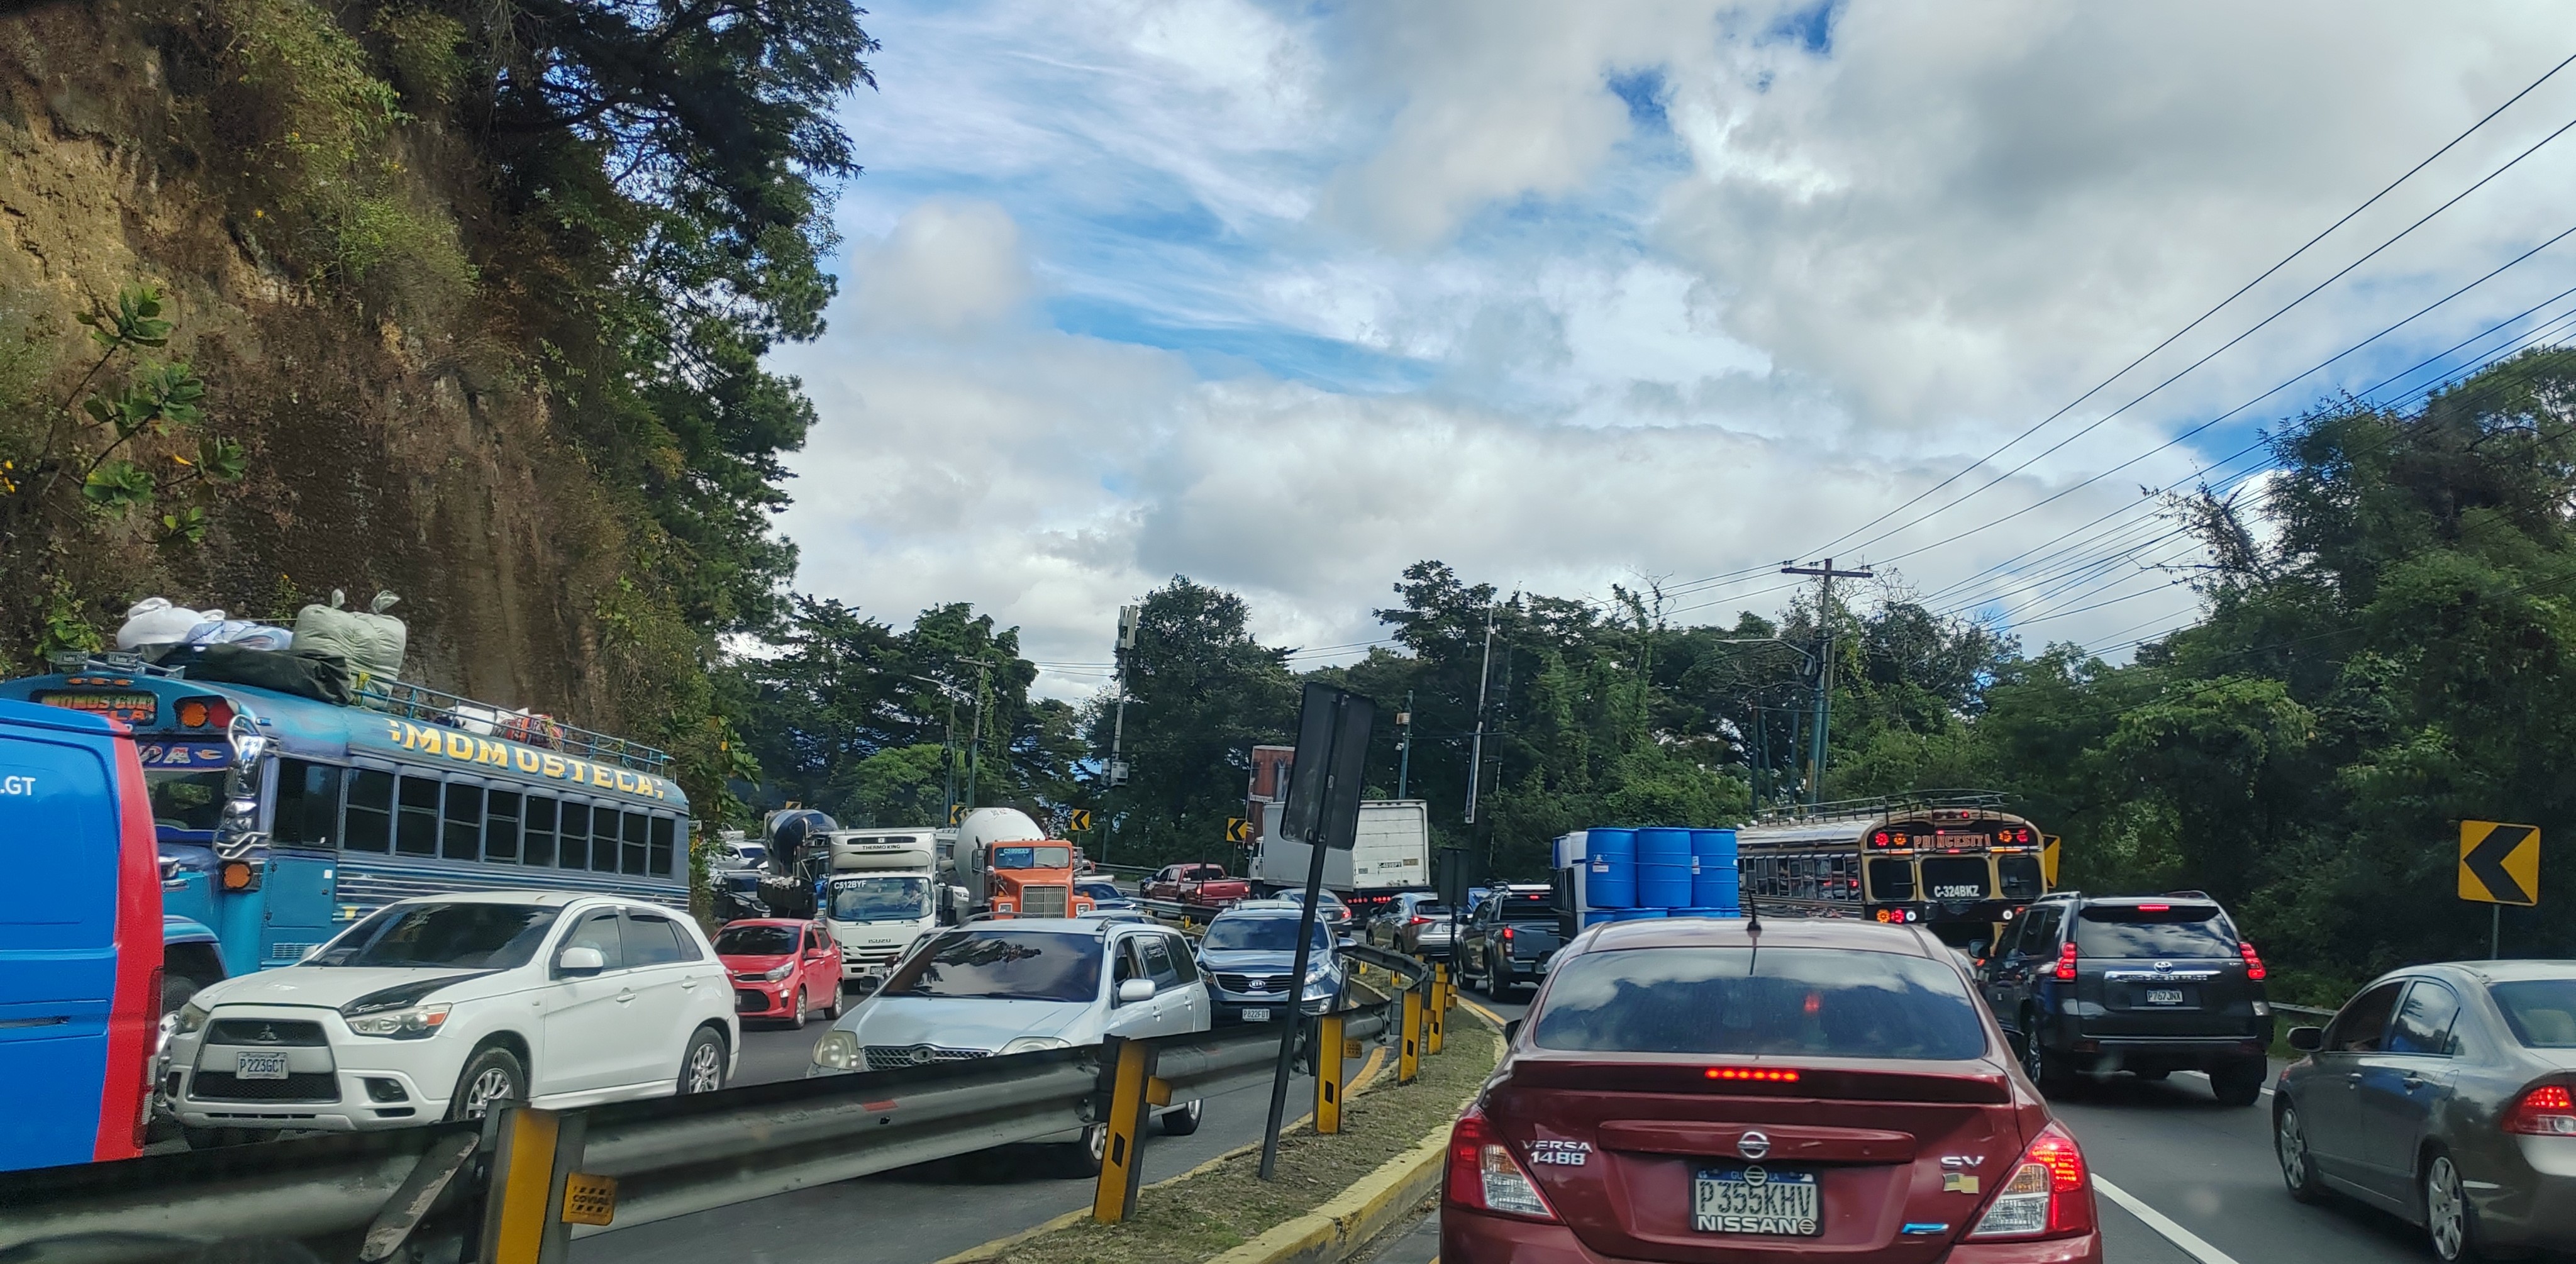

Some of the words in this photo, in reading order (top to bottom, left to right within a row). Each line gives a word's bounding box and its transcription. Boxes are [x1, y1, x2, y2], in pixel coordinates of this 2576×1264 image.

[401, 722, 660, 797] MOMOSTECA
[834, 880, 867, 890] C512BYF
[1934, 885, 1980, 898] C-324BKZ
[240, 1058, 285, 1073] P223GCT
[1521, 1139, 1593, 1153] VERSA
[1531, 1151, 1585, 1165] 1488
[1940, 1156, 1985, 1168] SV
[1699, 1181, 1811, 1217] P355KHV
[1698, 1216, 1799, 1234] NISSAN
